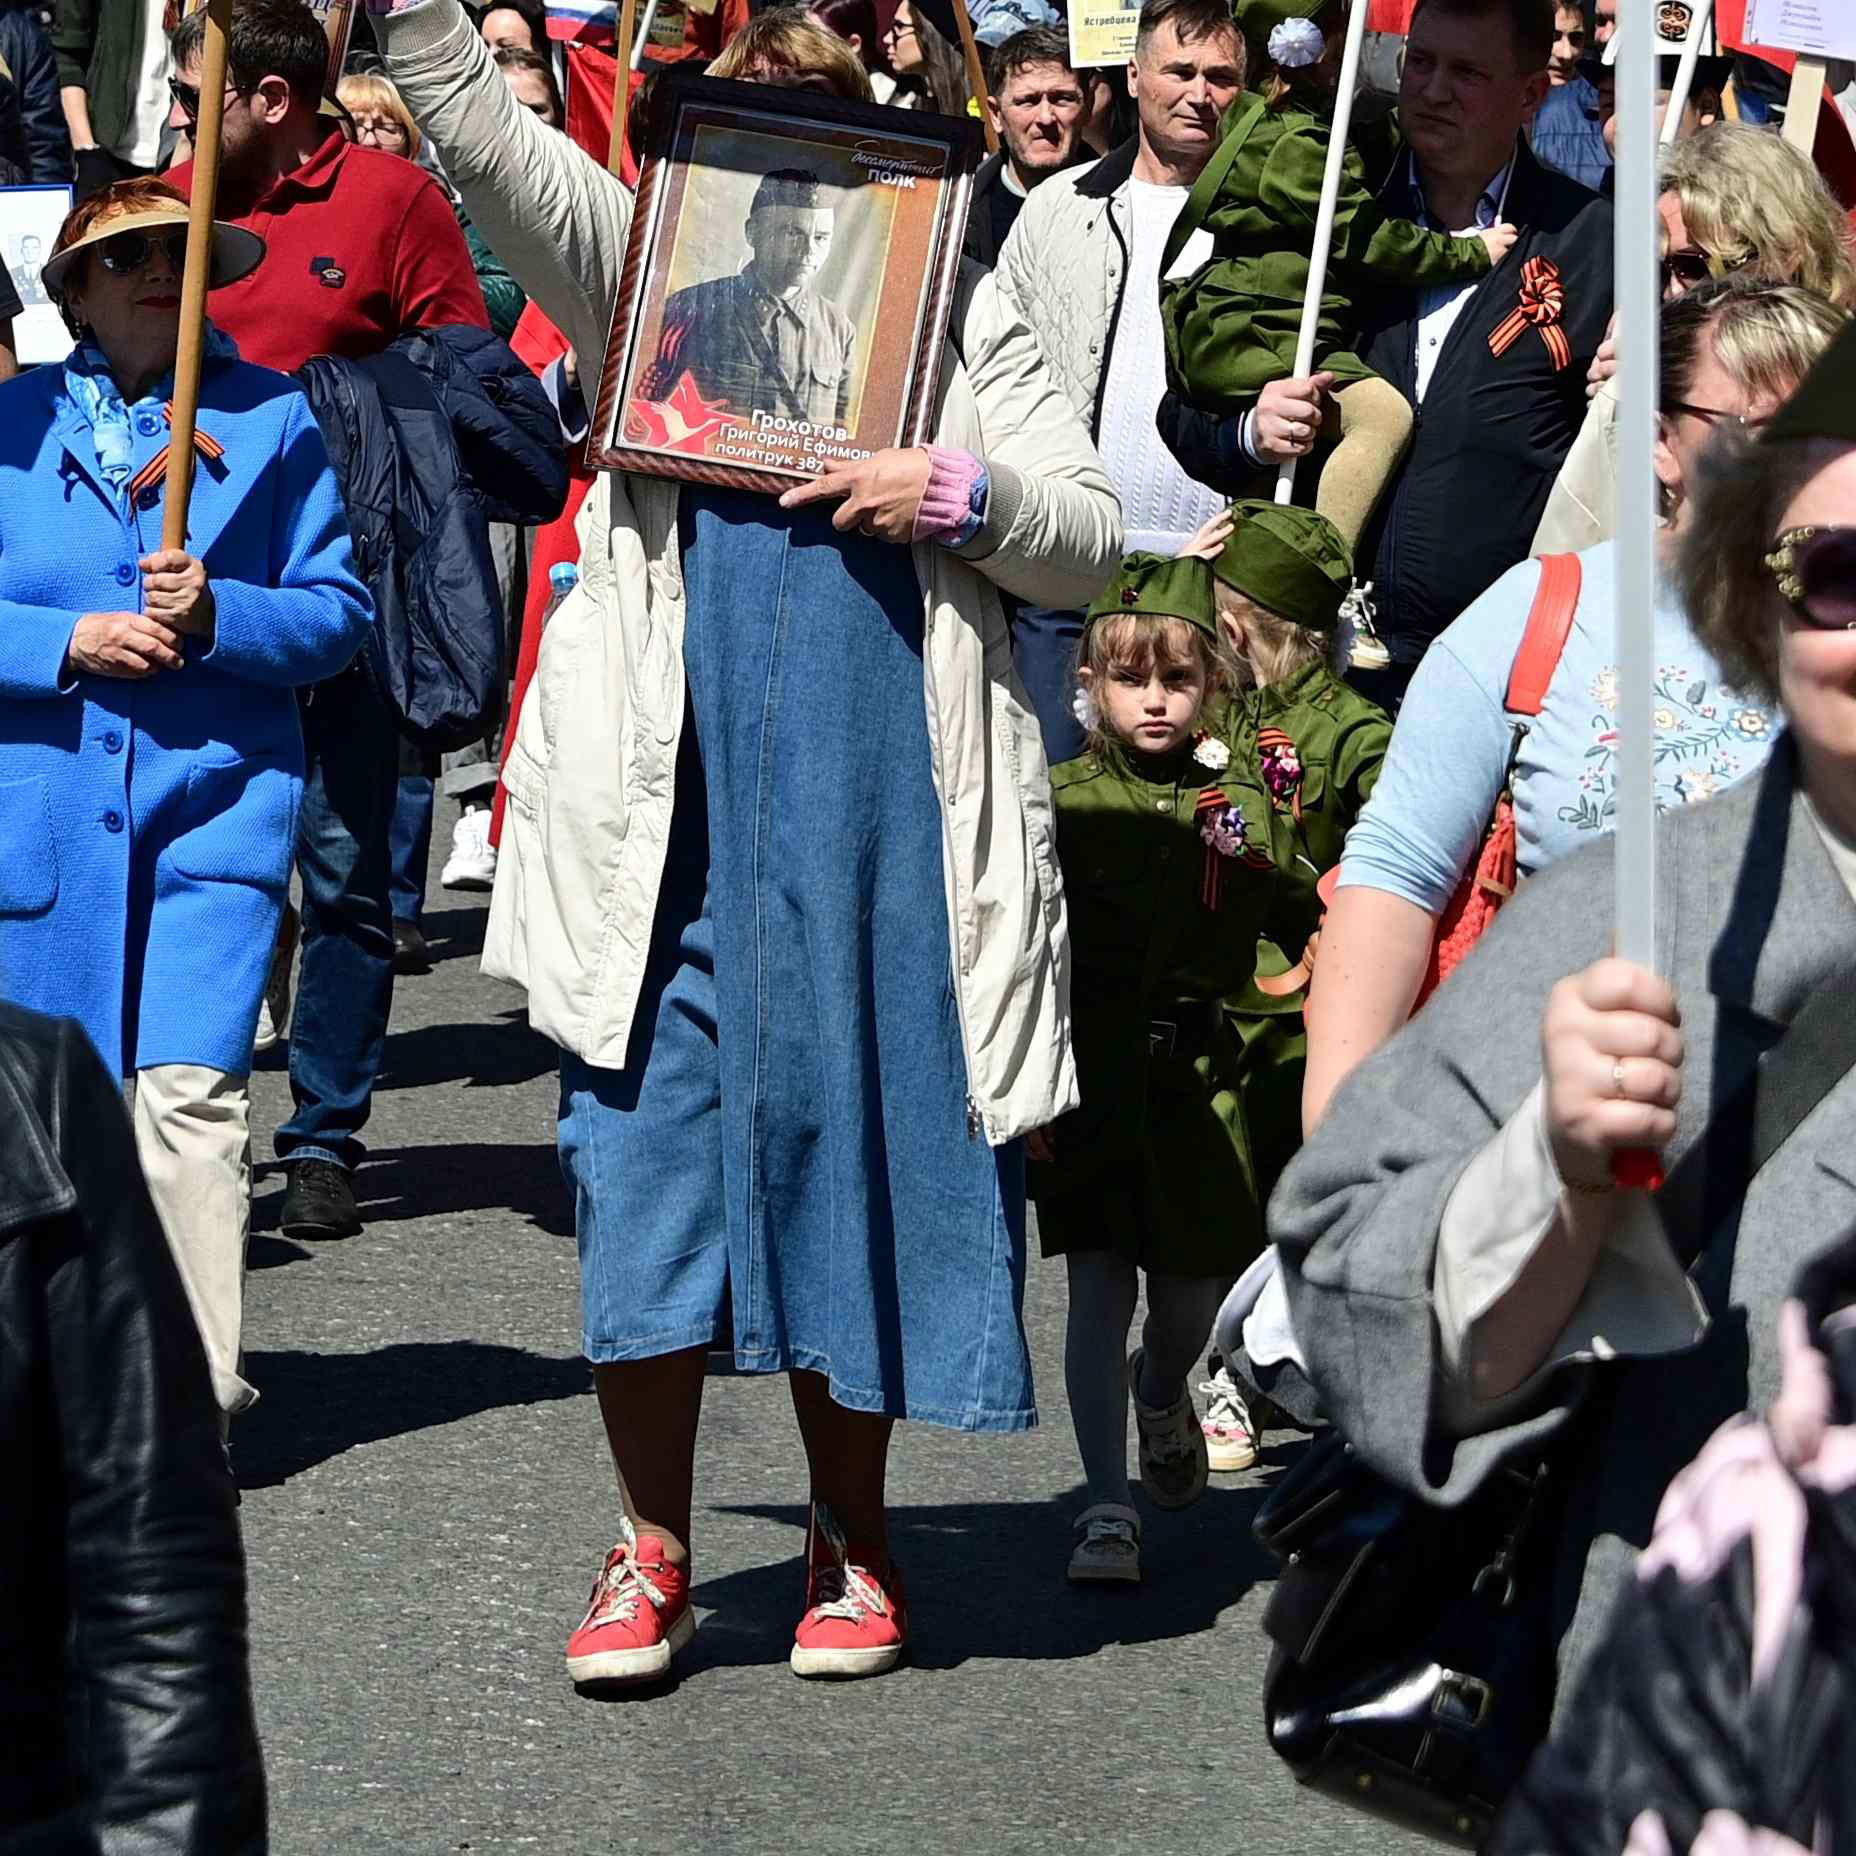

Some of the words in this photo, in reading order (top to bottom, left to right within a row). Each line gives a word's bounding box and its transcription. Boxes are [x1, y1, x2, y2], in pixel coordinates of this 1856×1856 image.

[867, 168, 917, 189] ПОЛК
[718, 422, 800, 450] Григорий
[802, 436, 876, 460] Ефимов
[751, 408, 849, 442] Грохотов
[715, 443, 794, 466] политрук
[795, 456, 825, 474] 387
